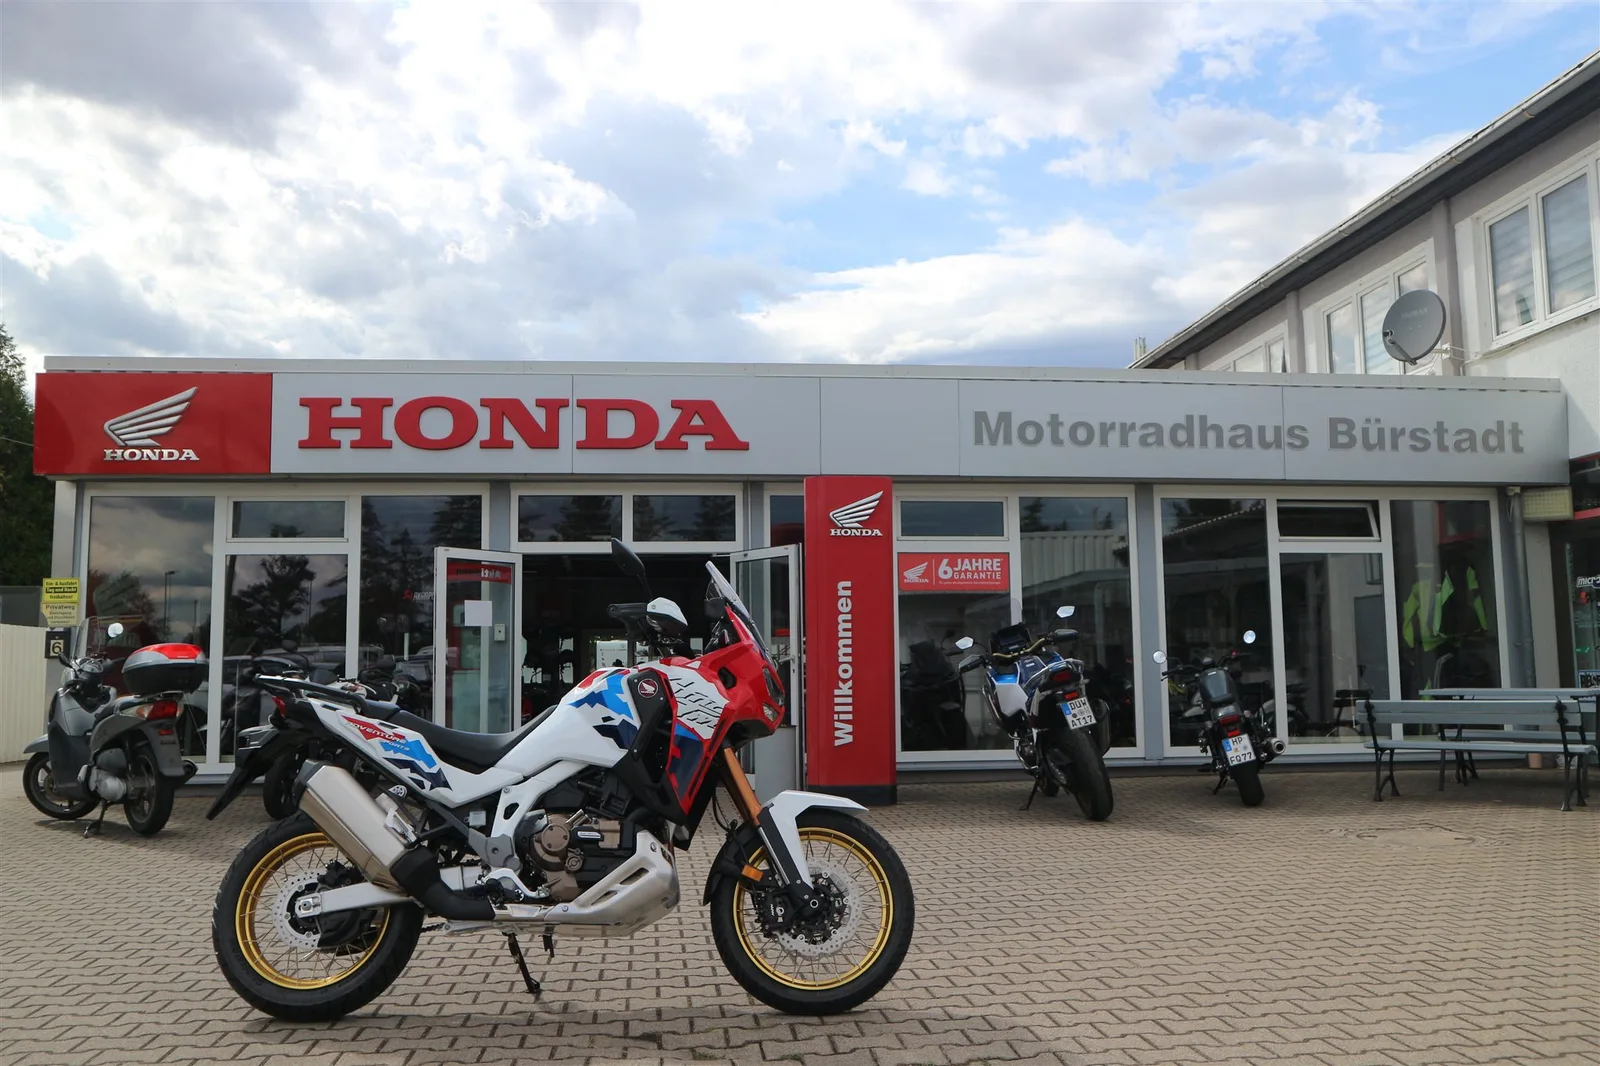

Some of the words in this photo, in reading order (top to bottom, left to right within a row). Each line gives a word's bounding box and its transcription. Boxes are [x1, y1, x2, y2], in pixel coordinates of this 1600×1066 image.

[298, 396, 749, 450] HONDA
[973, 410, 1310, 451] Motorradhaus
[1328, 416, 1524, 454] Bürstadt
[103, 448, 200, 461] HONDA
[830, 528, 883, 537] HONDA
[938, 558, 953, 579] 6
[953, 571, 1001, 580] GARANTIE
[51, 641, 62, 655] 6
[834, 580, 854, 747] Willkommen
[1070, 699, 1087, 710] DUW
[1071, 714, 1093, 728] AT17
[1231, 736, 1243, 746] HP
